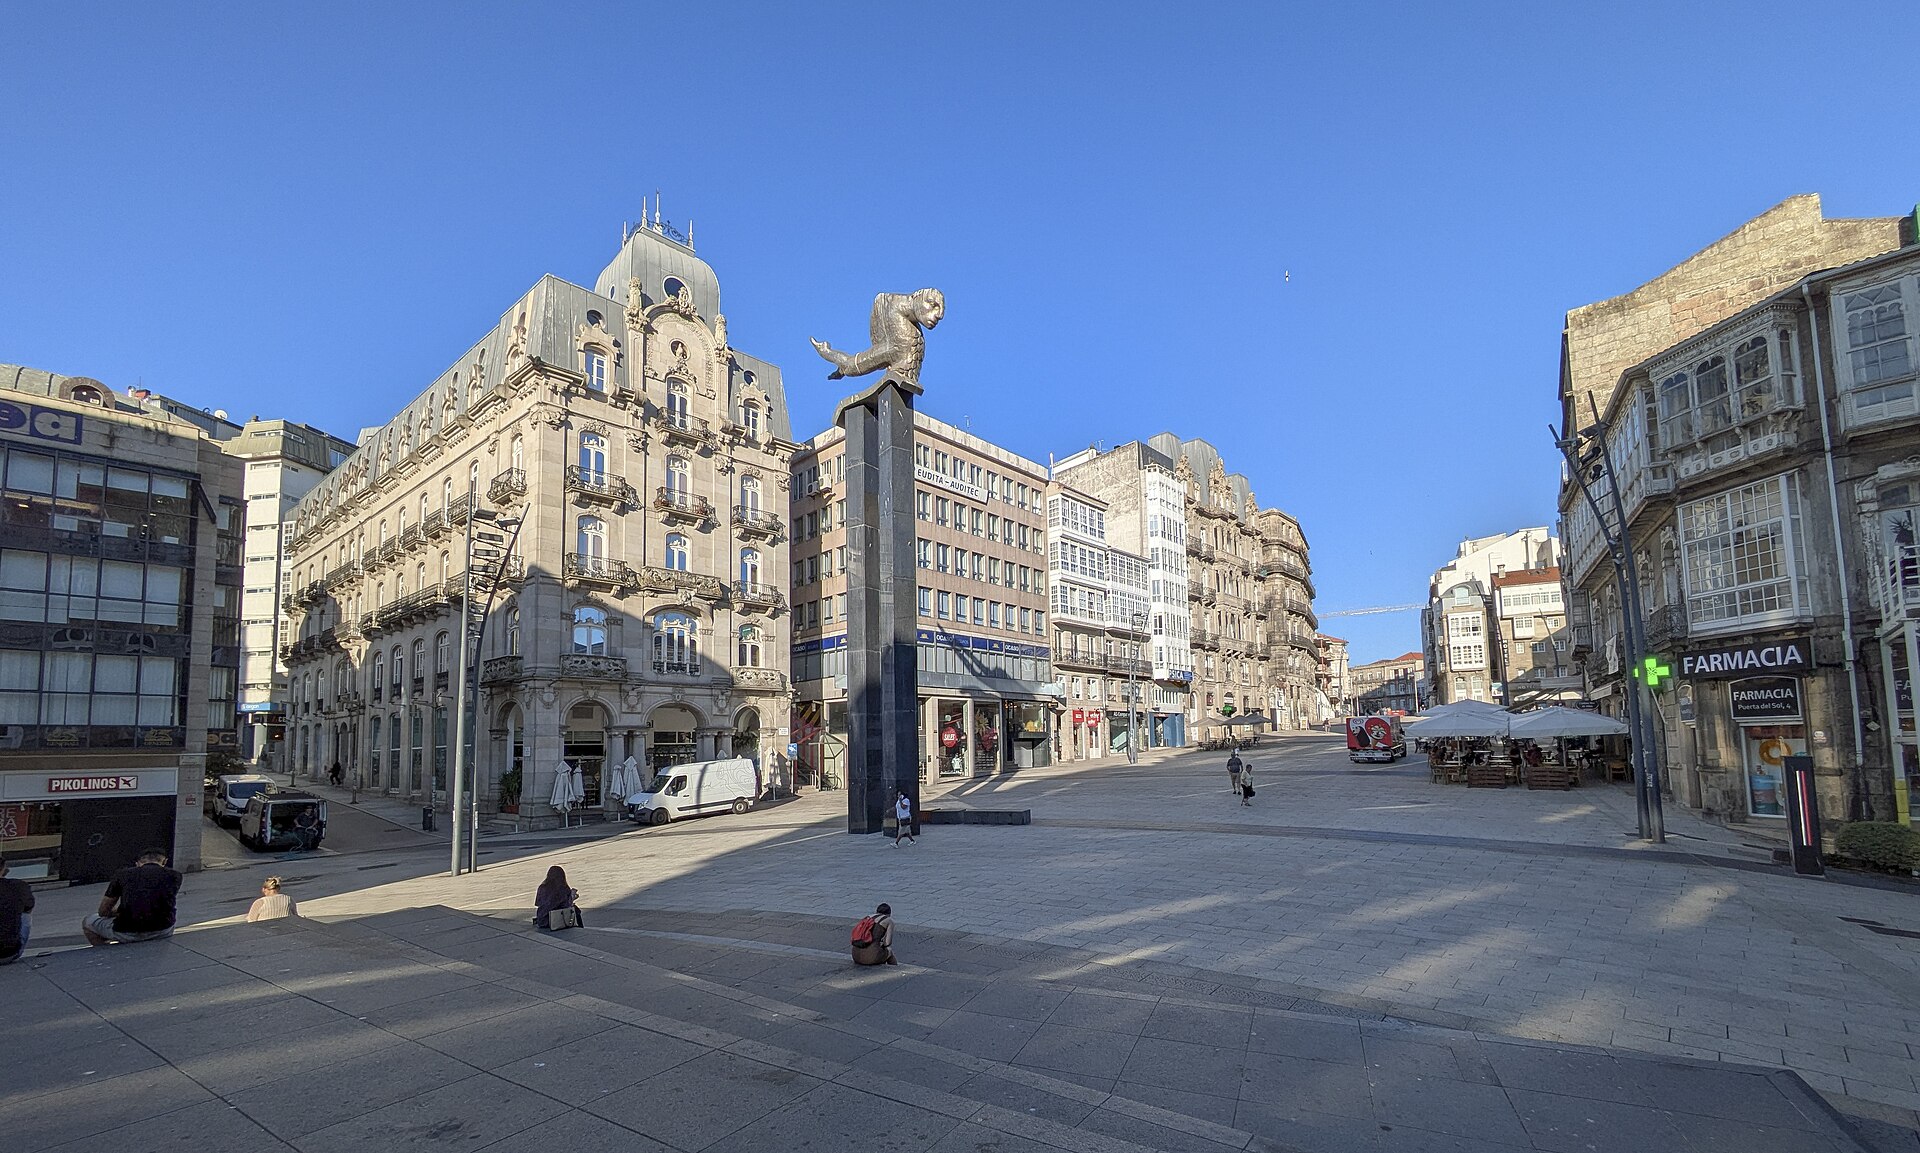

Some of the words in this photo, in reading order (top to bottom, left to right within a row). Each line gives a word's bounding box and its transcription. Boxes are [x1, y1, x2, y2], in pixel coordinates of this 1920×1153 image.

[917, 469, 944, 484] EUDITA
[950, 481, 979, 496] AUDITEC
[1004, 644, 1020, 652] OCASO
[1682, 645, 1803, 675] FARMACIA
[1732, 688, 1794, 702] FARMACIA
[1771, 702, 1785, 710] Sol,
[51, 777, 117, 791] PIKOLINOS
